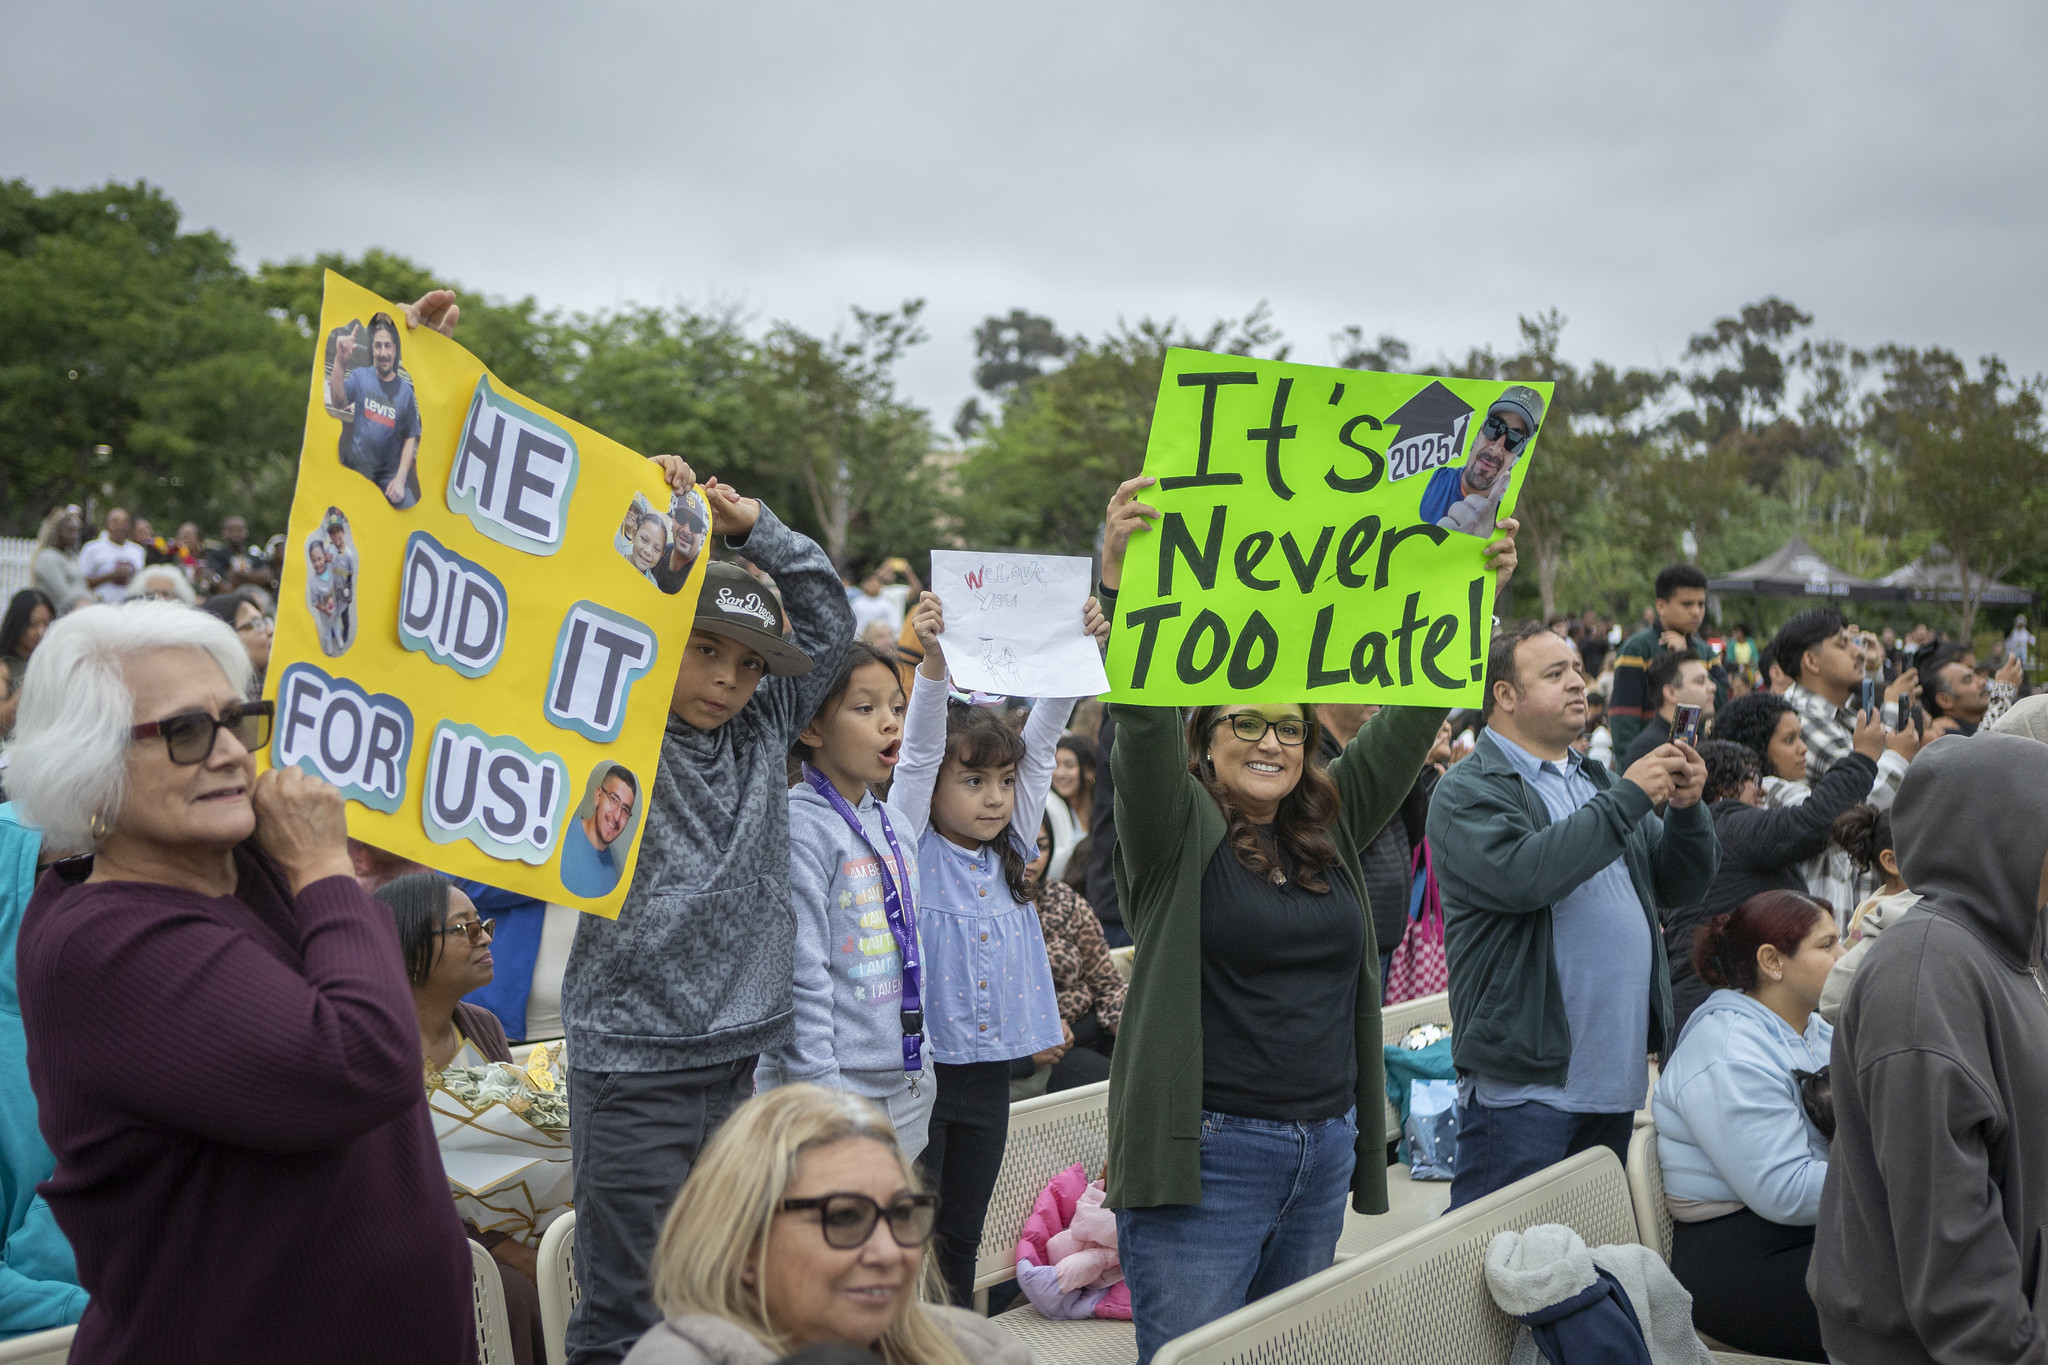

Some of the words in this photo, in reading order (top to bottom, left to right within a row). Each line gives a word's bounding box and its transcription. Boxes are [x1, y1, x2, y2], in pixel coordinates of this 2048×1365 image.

[456, 394, 565, 537] HE
[1160, 371, 1385, 501] It's
[1391, 433, 1450, 480] 2025
[1158, 505, 1449, 597] Never
[405, 552, 499, 661] DID
[554, 619, 645, 727] IT
[715, 588, 744, 609] San
[744, 593, 776, 628] Diego
[1126, 602, 1279, 690] TOO
[1306, 576, 1485, 690] Late!
[283, 677, 402, 792] FOR
[435, 737, 555, 846] US!
[866, 935, 884, 951] AM
[866, 958, 886, 976] AM
[872, 984, 876, 999] I
[878, 980, 892, 998] AM
